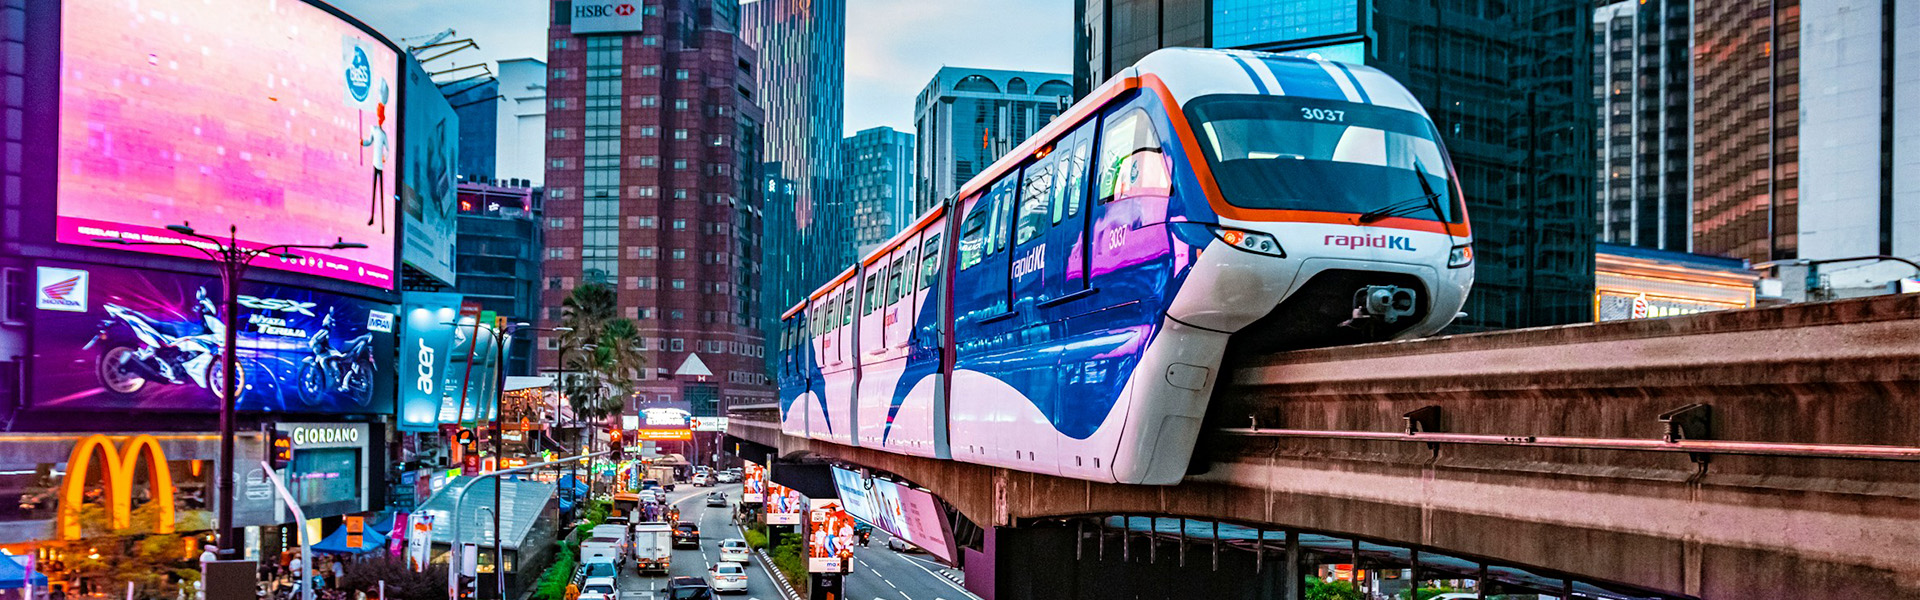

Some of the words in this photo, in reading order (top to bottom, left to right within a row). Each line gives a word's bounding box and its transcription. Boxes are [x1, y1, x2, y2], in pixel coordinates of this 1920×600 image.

[574, 4, 613, 18] HSBC
[1300, 106, 1345, 123] 3037
[1108, 224, 1128, 250] 3037
[1323, 233, 1417, 252] rapidKL
[1010, 243, 1046, 283] rapidKL
[41, 298, 81, 306] HONDA
[248, 313, 287, 327] NYATA
[417, 337, 435, 395] acer
[293, 426, 359, 445] GIORDANO
